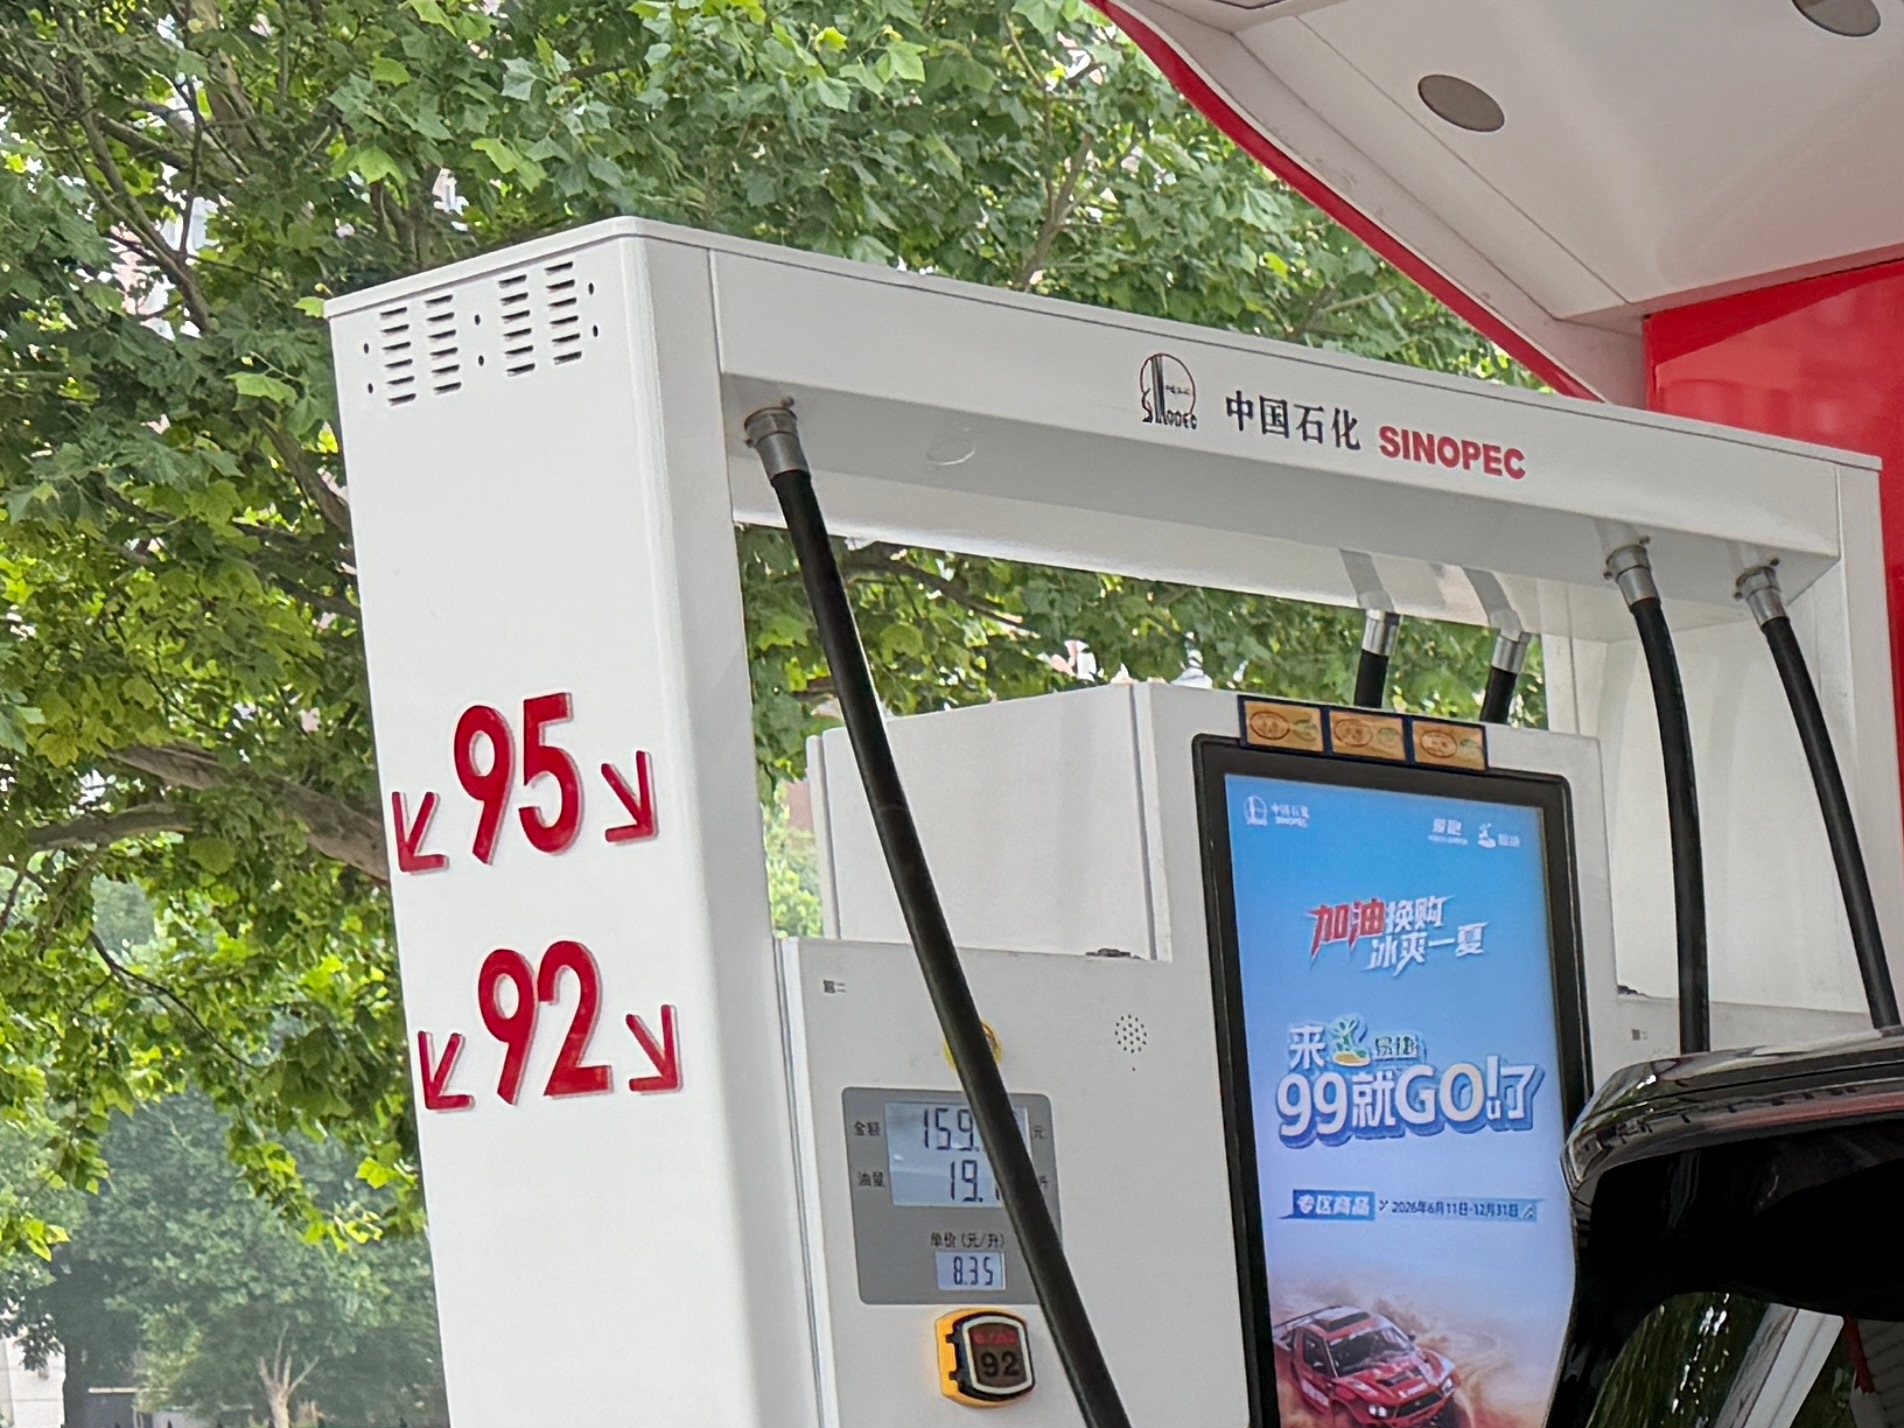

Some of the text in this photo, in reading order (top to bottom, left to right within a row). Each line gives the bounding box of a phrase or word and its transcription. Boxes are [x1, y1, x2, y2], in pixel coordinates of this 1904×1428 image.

[1225, 389, 1527, 480] 中国石化 SINOPEC
[453, 691, 585, 866] 95
[1304, 895, 1455, 962] 加油换购
[1364, 921, 1489, 977] 冰爽一夏
[478, 940, 614, 1106] 92
[1288, 1024, 1326, 1070] 来
[952, 1256, 994, 1287] 8.35
[981, 1350, 1021, 1378] 92
